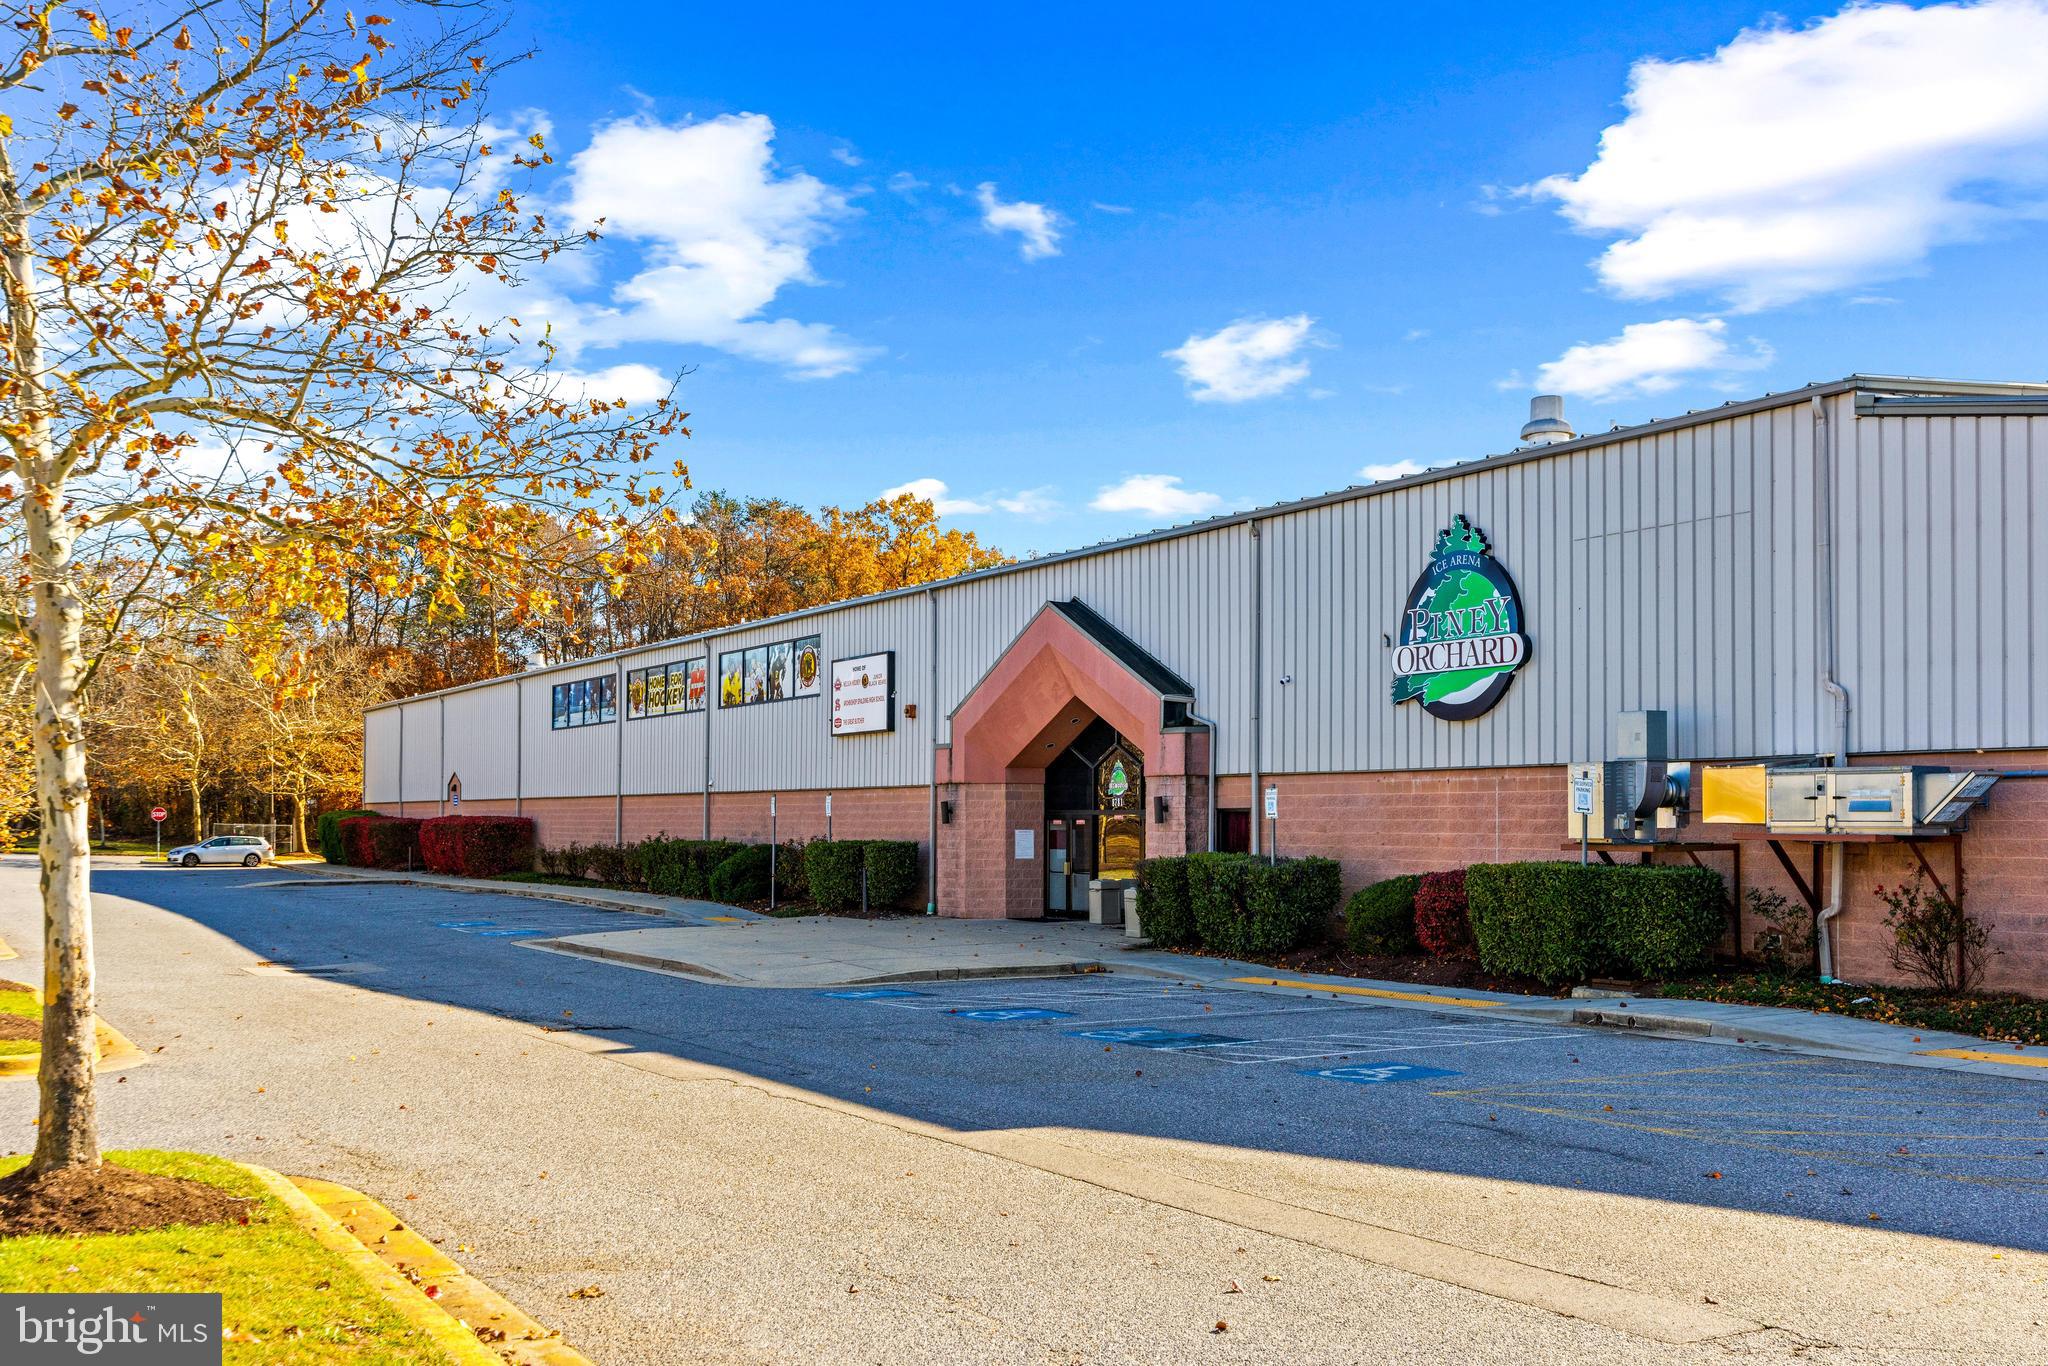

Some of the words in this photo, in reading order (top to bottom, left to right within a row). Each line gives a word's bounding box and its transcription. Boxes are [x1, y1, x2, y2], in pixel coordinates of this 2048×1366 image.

[1432, 559, 1448, 575] ICE
[1450, 554, 1481, 568] ARENA
[1408, 596, 1511, 642] PINEY
[1397, 636, 1517, 674] ORCHARD
[649, 675, 665, 689] HOME
[670, 672, 682, 686] FOR
[648, 687, 684, 708] HOCKEY
